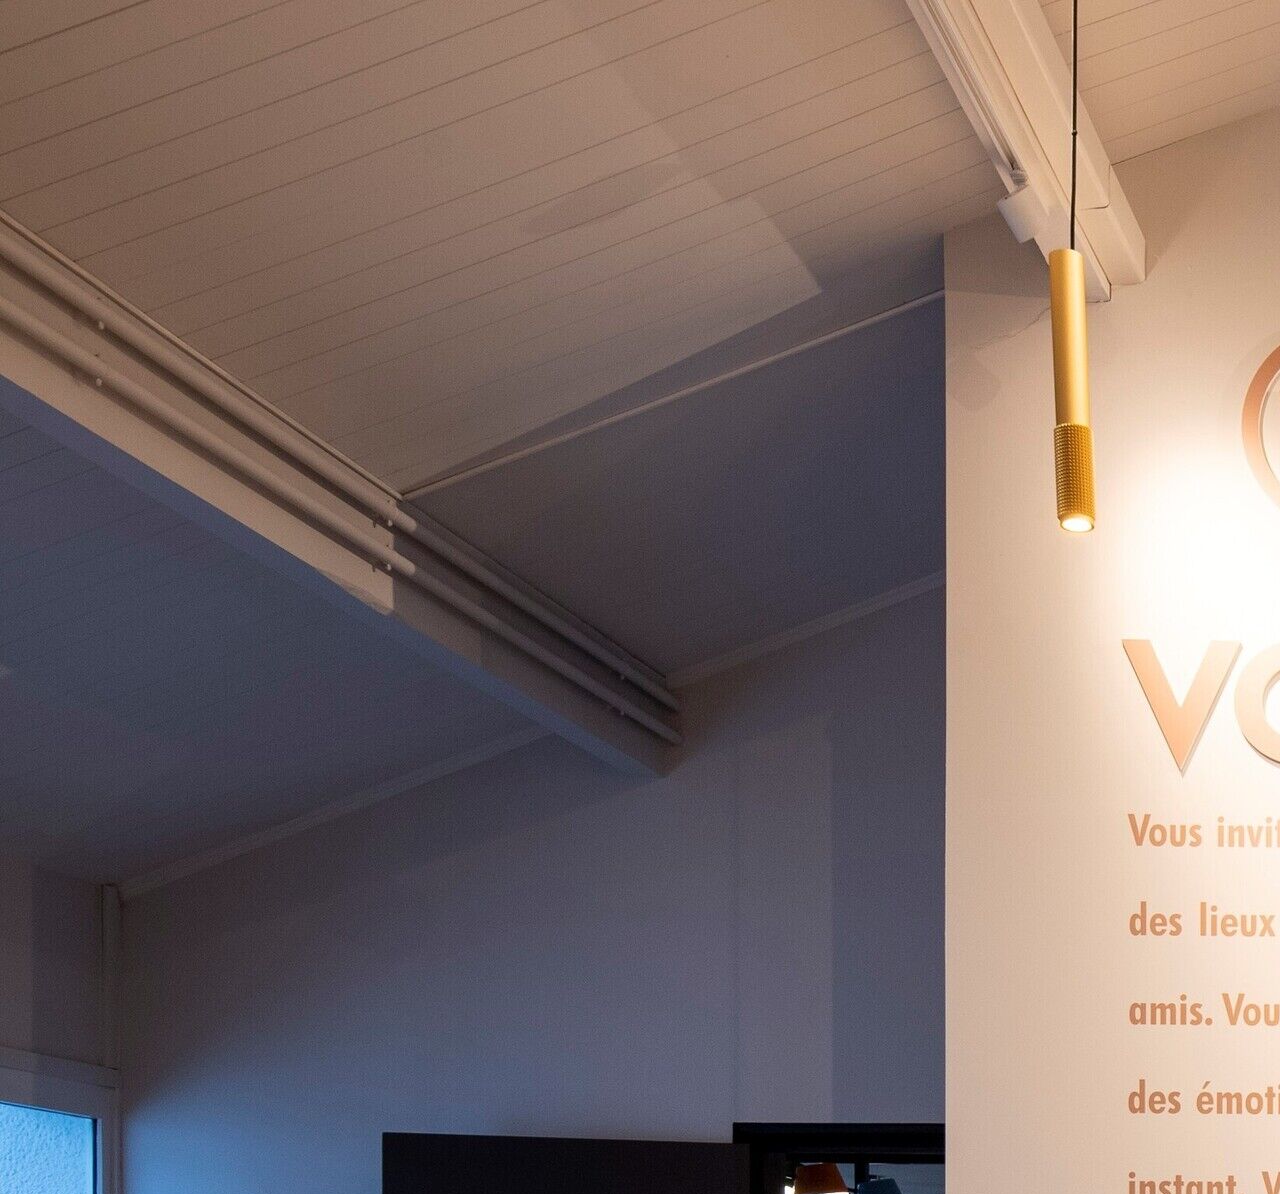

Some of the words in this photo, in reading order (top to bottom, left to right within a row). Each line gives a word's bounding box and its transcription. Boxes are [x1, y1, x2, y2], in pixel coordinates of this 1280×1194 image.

[1127, 813, 1202, 848] Vous
[1128, 900, 1183, 937] des
[1198, 900, 1274, 938] lieux
[1128, 992, 1214, 1026] amis.
[1126, 1078, 1182, 1115] des
